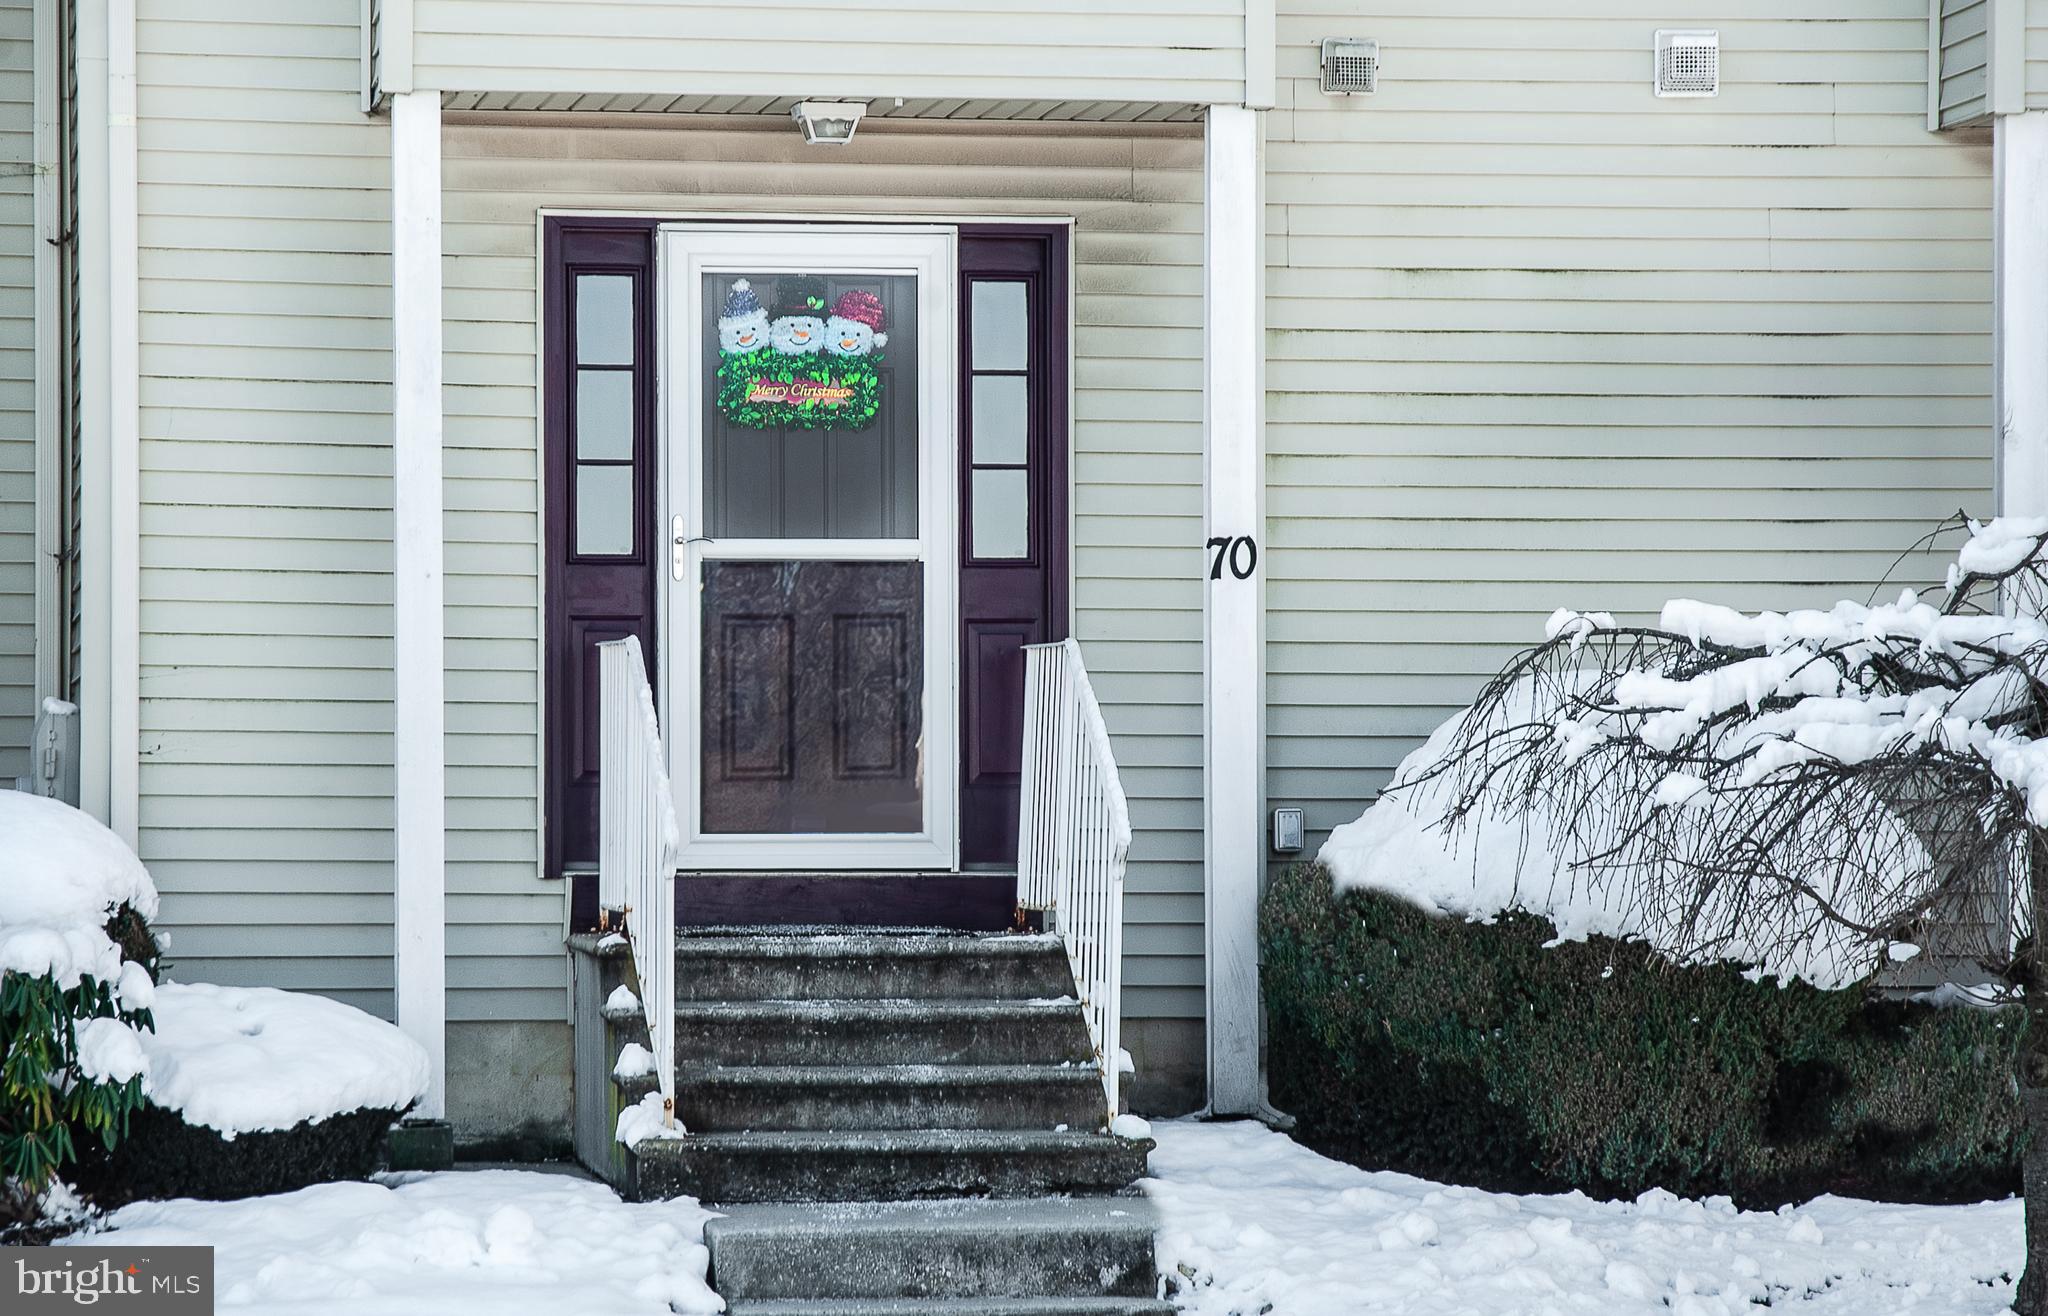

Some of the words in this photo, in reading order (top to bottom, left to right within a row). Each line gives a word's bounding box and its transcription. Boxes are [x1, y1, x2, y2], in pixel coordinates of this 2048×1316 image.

[752, 384, 788, 397] Merry
[791, 384, 851, 398] Christmas
[1206, 535, 1257, 580] 70
